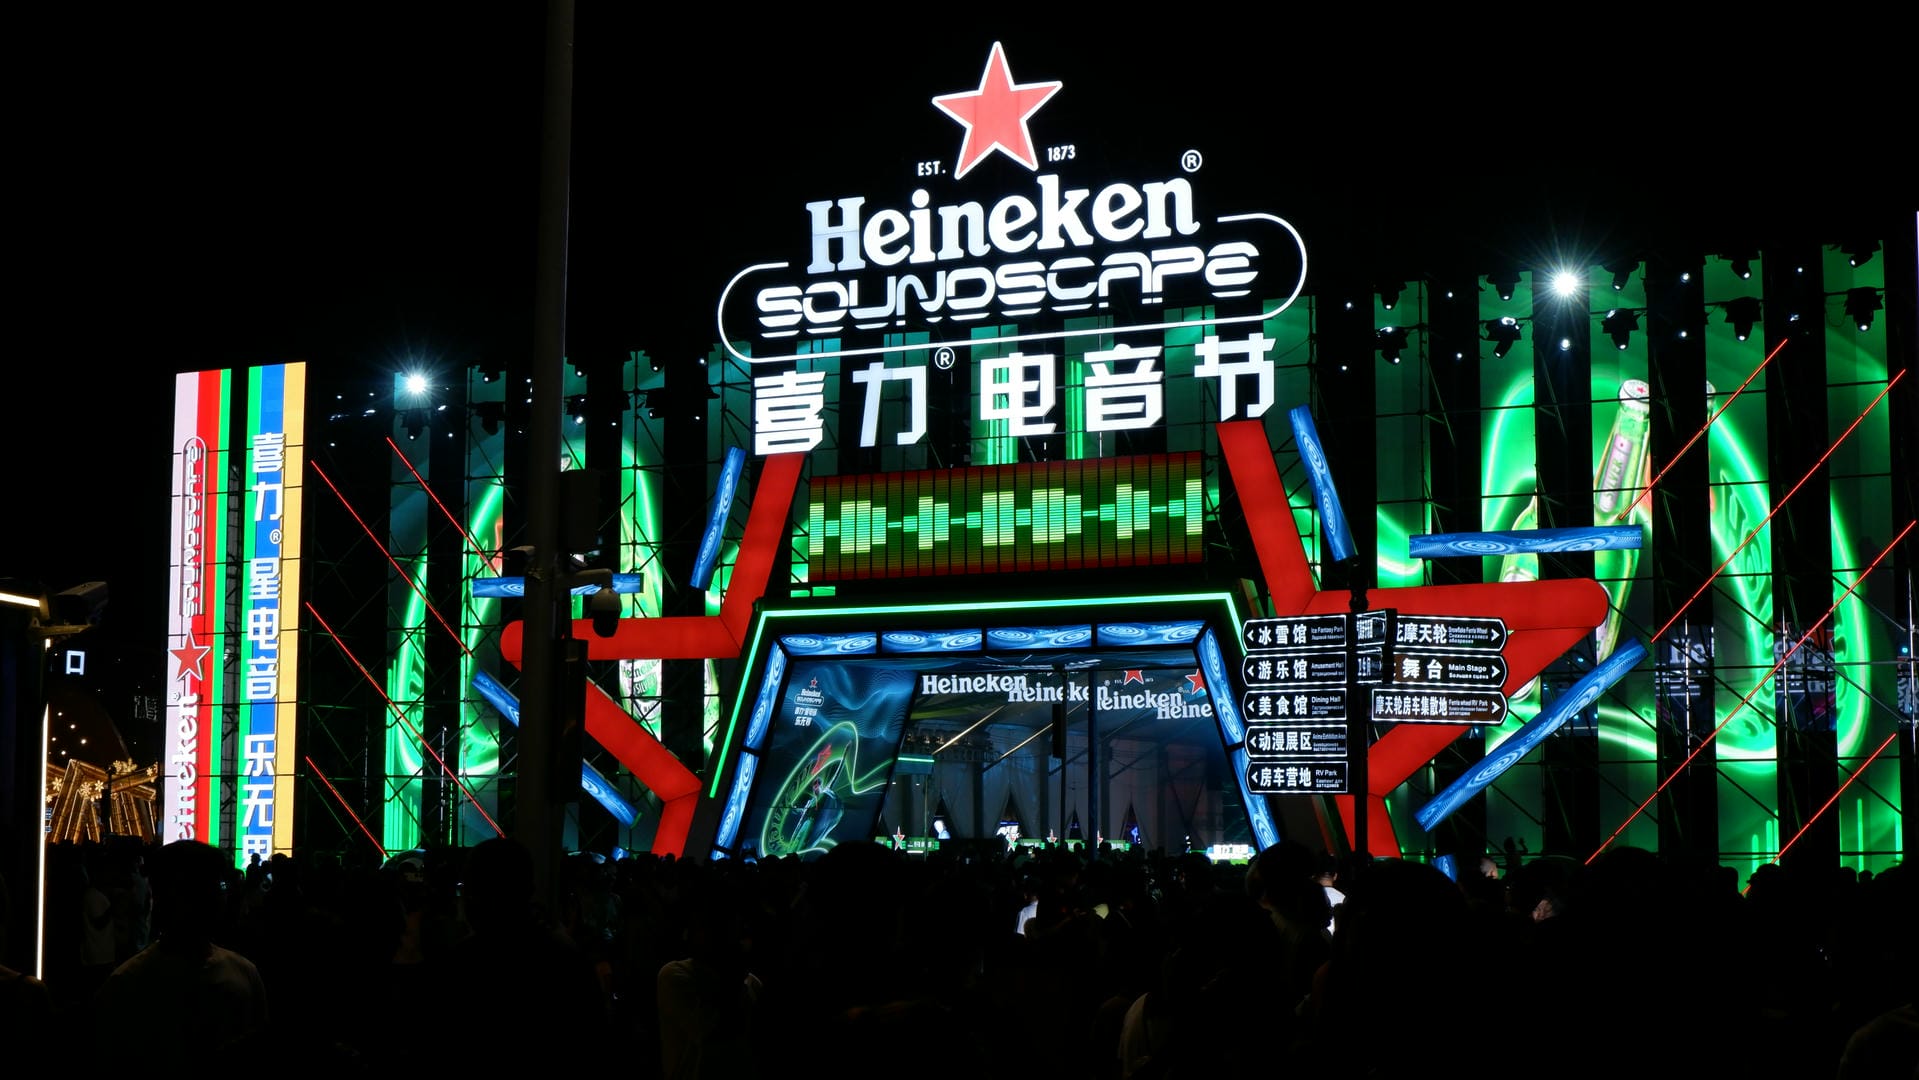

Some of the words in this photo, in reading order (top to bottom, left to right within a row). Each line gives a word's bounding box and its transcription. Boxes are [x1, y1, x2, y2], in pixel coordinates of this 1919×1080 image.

[917, 160, 946, 176] EST.
[1047, 145, 1076, 161] 1873
[805, 174, 1200, 275] Heineken
[757, 241, 1260, 339] SOUNDSCAPE
[1258, 624, 1307, 645] 冰雪馆
[1334, 625, 1344, 633] Park
[1258, 659, 1308, 681] 游乐馆
[1394, 657, 1443, 680] 舞台
[1467, 664, 1487, 673] Stage
[921, 674, 1027, 695] Heineken
[1096, 690, 1183, 710] eineken
[1156, 700, 1214, 720] Heine
[1258, 694, 1308, 716] 美食馆
[1312, 695, 1329, 704] Dining
[1375, 695, 1448, 717] 摩天轮房车集散地
[1258, 731, 1313, 752] 动漫展区
[172, 692, 199, 841] eineken
[1259, 766, 1312, 787] 房车营地
